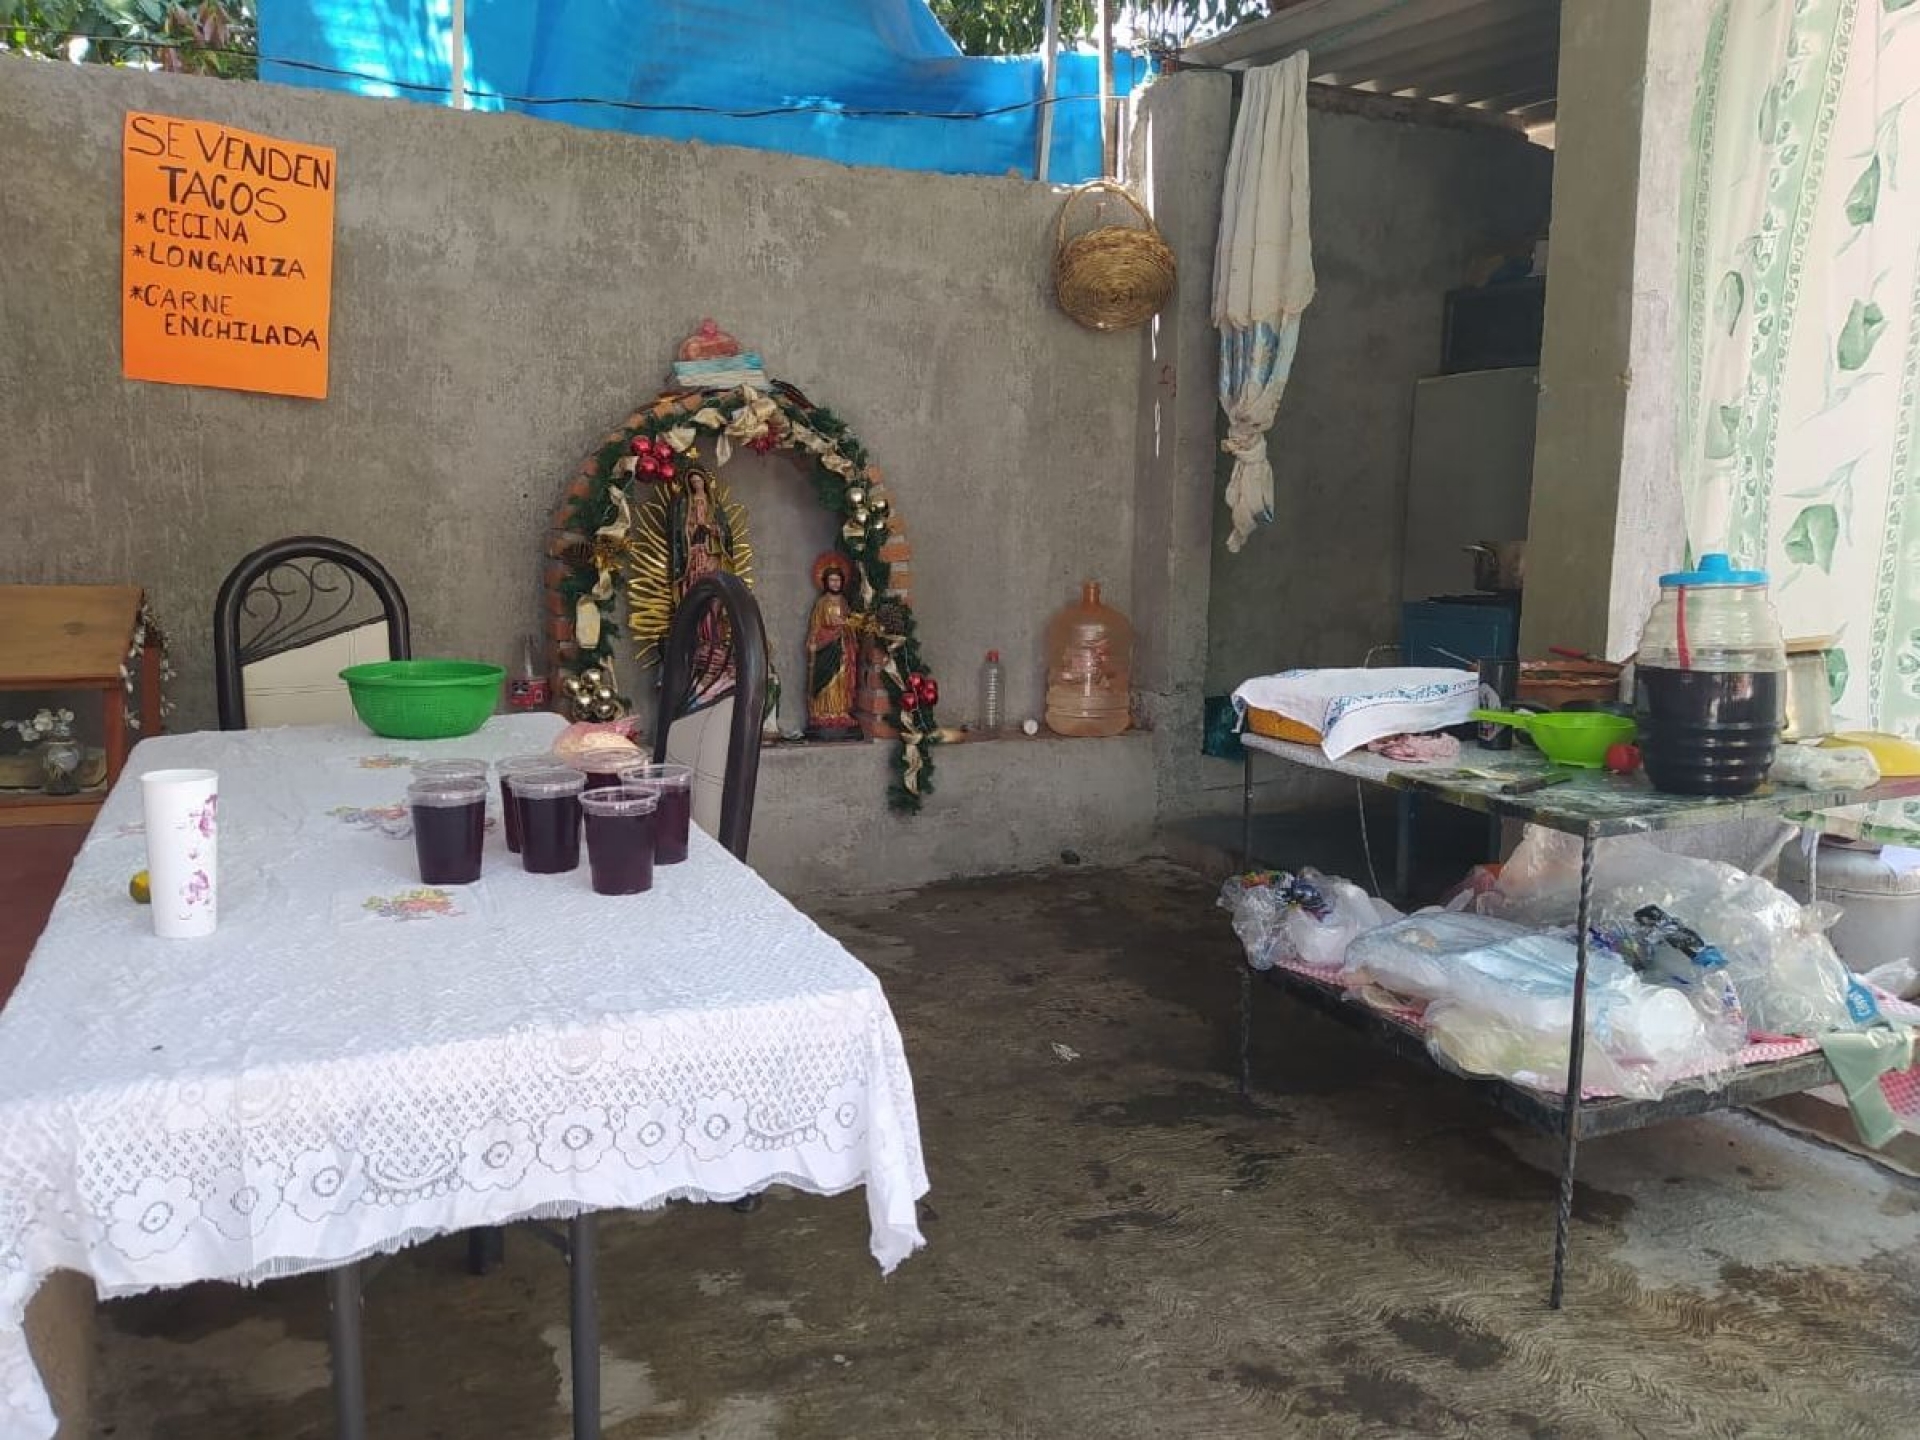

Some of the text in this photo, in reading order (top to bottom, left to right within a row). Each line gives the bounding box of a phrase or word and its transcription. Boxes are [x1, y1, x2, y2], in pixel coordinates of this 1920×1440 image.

[128, 116, 330, 190] SE VENDEN
[158, 165, 287, 223] TACOS
[152, 207, 249, 243] CECINA
[149, 241, 305, 280] LONGANIZA
[143, 284, 233, 316] CARNE
[165, 313, 320, 351] ENCHILADA
